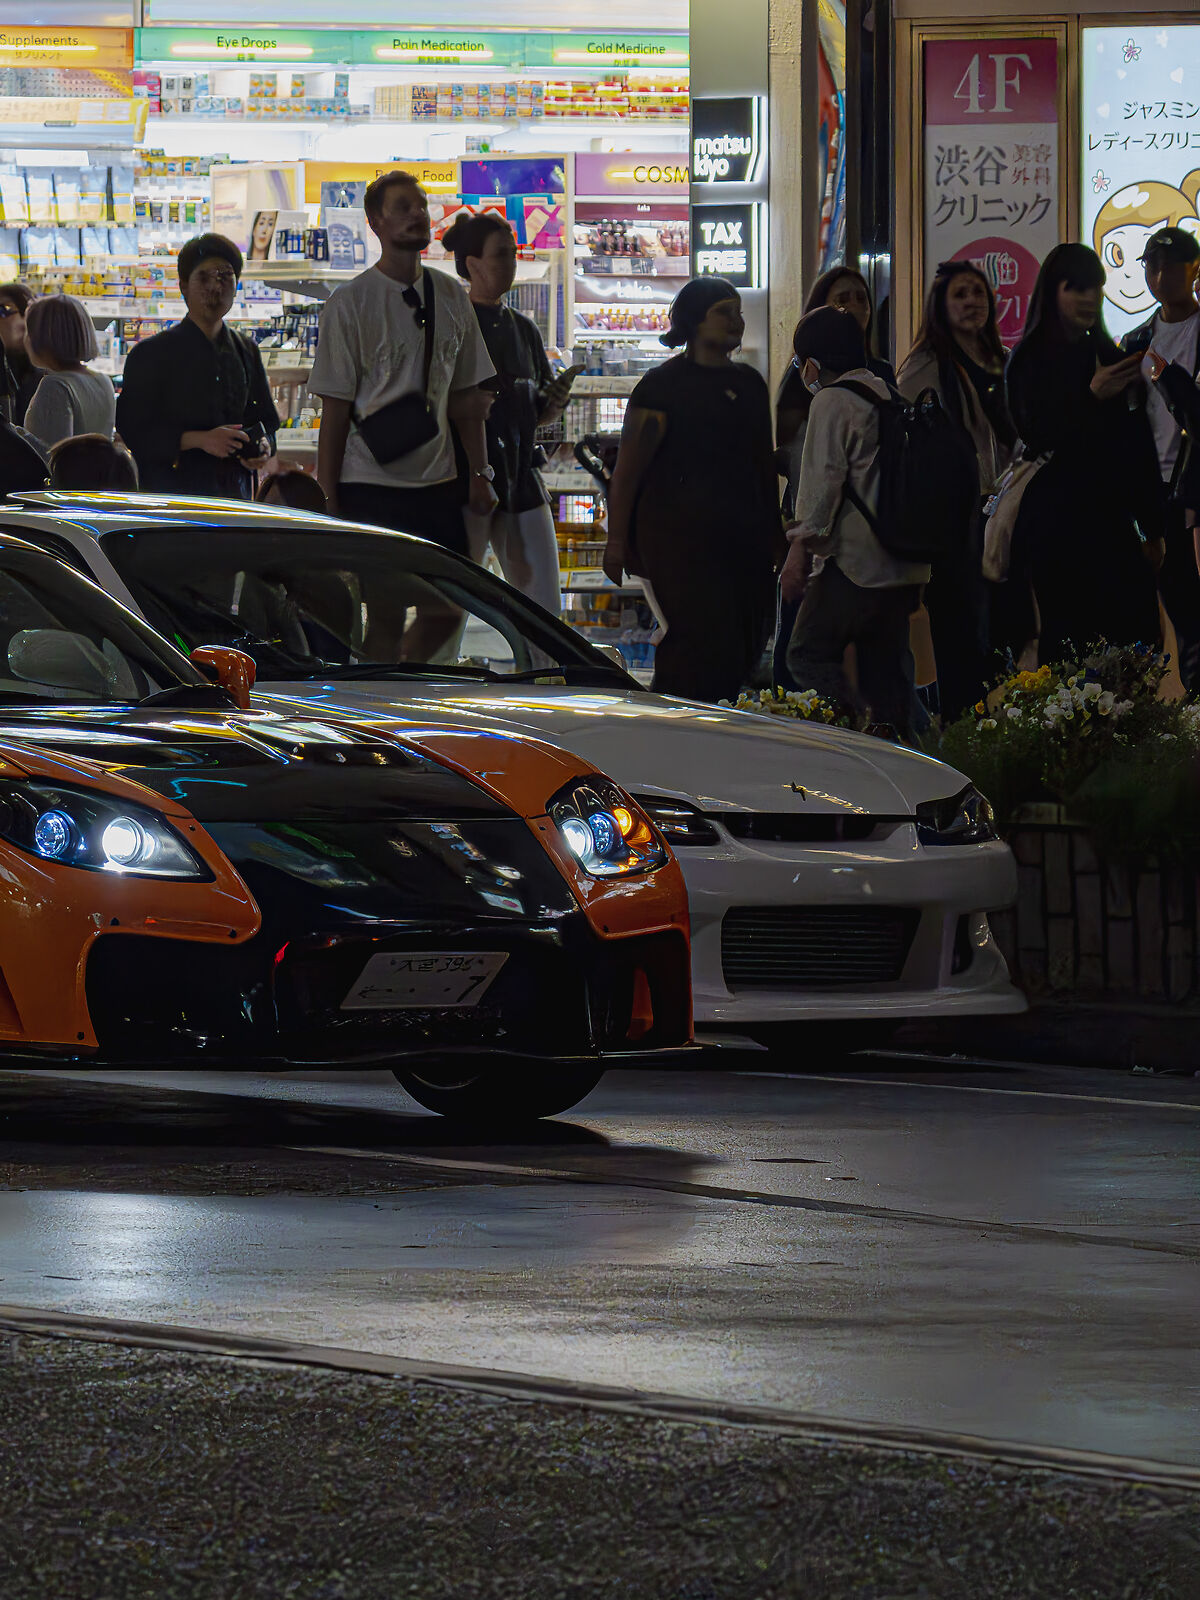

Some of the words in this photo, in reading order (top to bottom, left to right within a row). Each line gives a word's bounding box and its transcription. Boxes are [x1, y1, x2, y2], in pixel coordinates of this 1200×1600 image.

[0, 34, 79, 48] Supplements
[216, 36, 240, 50] Eye
[241, 36, 277, 51] Drops
[393, 38, 419, 50] Pain
[421, 39, 485, 51] Medication
[587, 42, 612, 54] Cold
[615, 42, 666, 54] Medicine
[953, 53, 1033, 114] 4F
[1123, 101, 1200, 120] ジャスミン
[693, 134, 752, 156] matsu
[633, 165, 690, 184] COSM
[693, 153, 730, 183] kiyo
[934, 144, 1009, 187] 渋谷
[423, 170, 453, 182] Food
[934, 193, 1052, 228] クリニック
[700, 221, 743, 245] TAX
[697, 249, 747, 274] FREE
